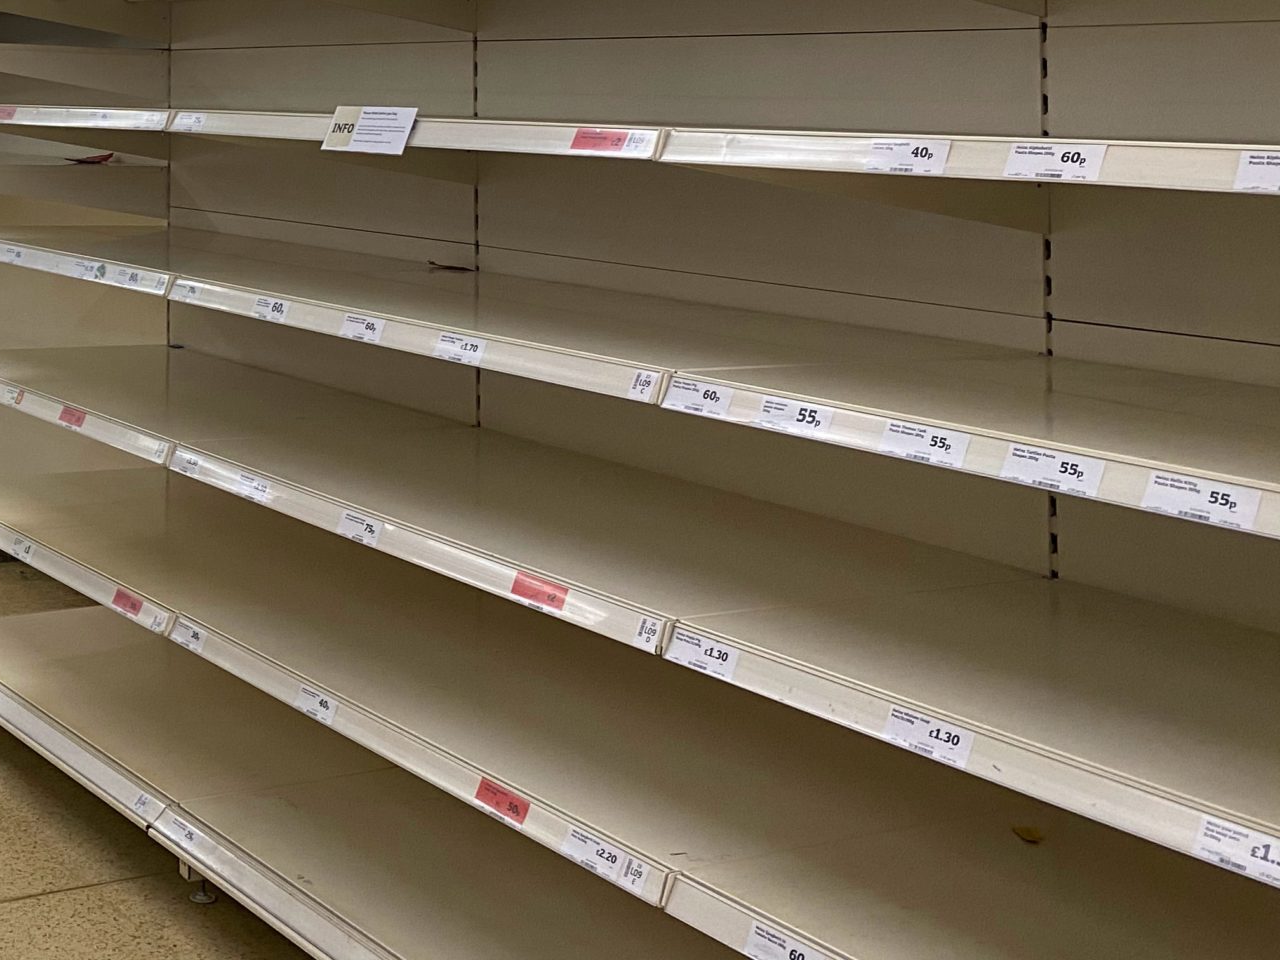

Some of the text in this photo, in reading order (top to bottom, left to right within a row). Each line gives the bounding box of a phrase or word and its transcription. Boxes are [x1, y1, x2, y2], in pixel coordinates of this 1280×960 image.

[332, 122, 355, 134] INFO
[911, 146, 934, 160] 40p
[1061, 152, 1086, 166] 60p
[271, 302, 285, 316] 60p
[364, 321, 377, 334] 60p
[460, 342, 479, 353] £1.70
[702, 389, 721, 403] 60p
[796, 407, 822, 428] 55p
[929, 435, 952, 452] 55p
[1058, 461, 1085, 479] 55p
[1208, 490, 1238, 510] 55p
[704, 646, 729, 662] £1.30
[318, 698, 330, 711] 40p
[928, 728, 961, 747] £1.30
[595, 847, 618, 865] £2.20
[1249, 843, 1280, 867] £1.
